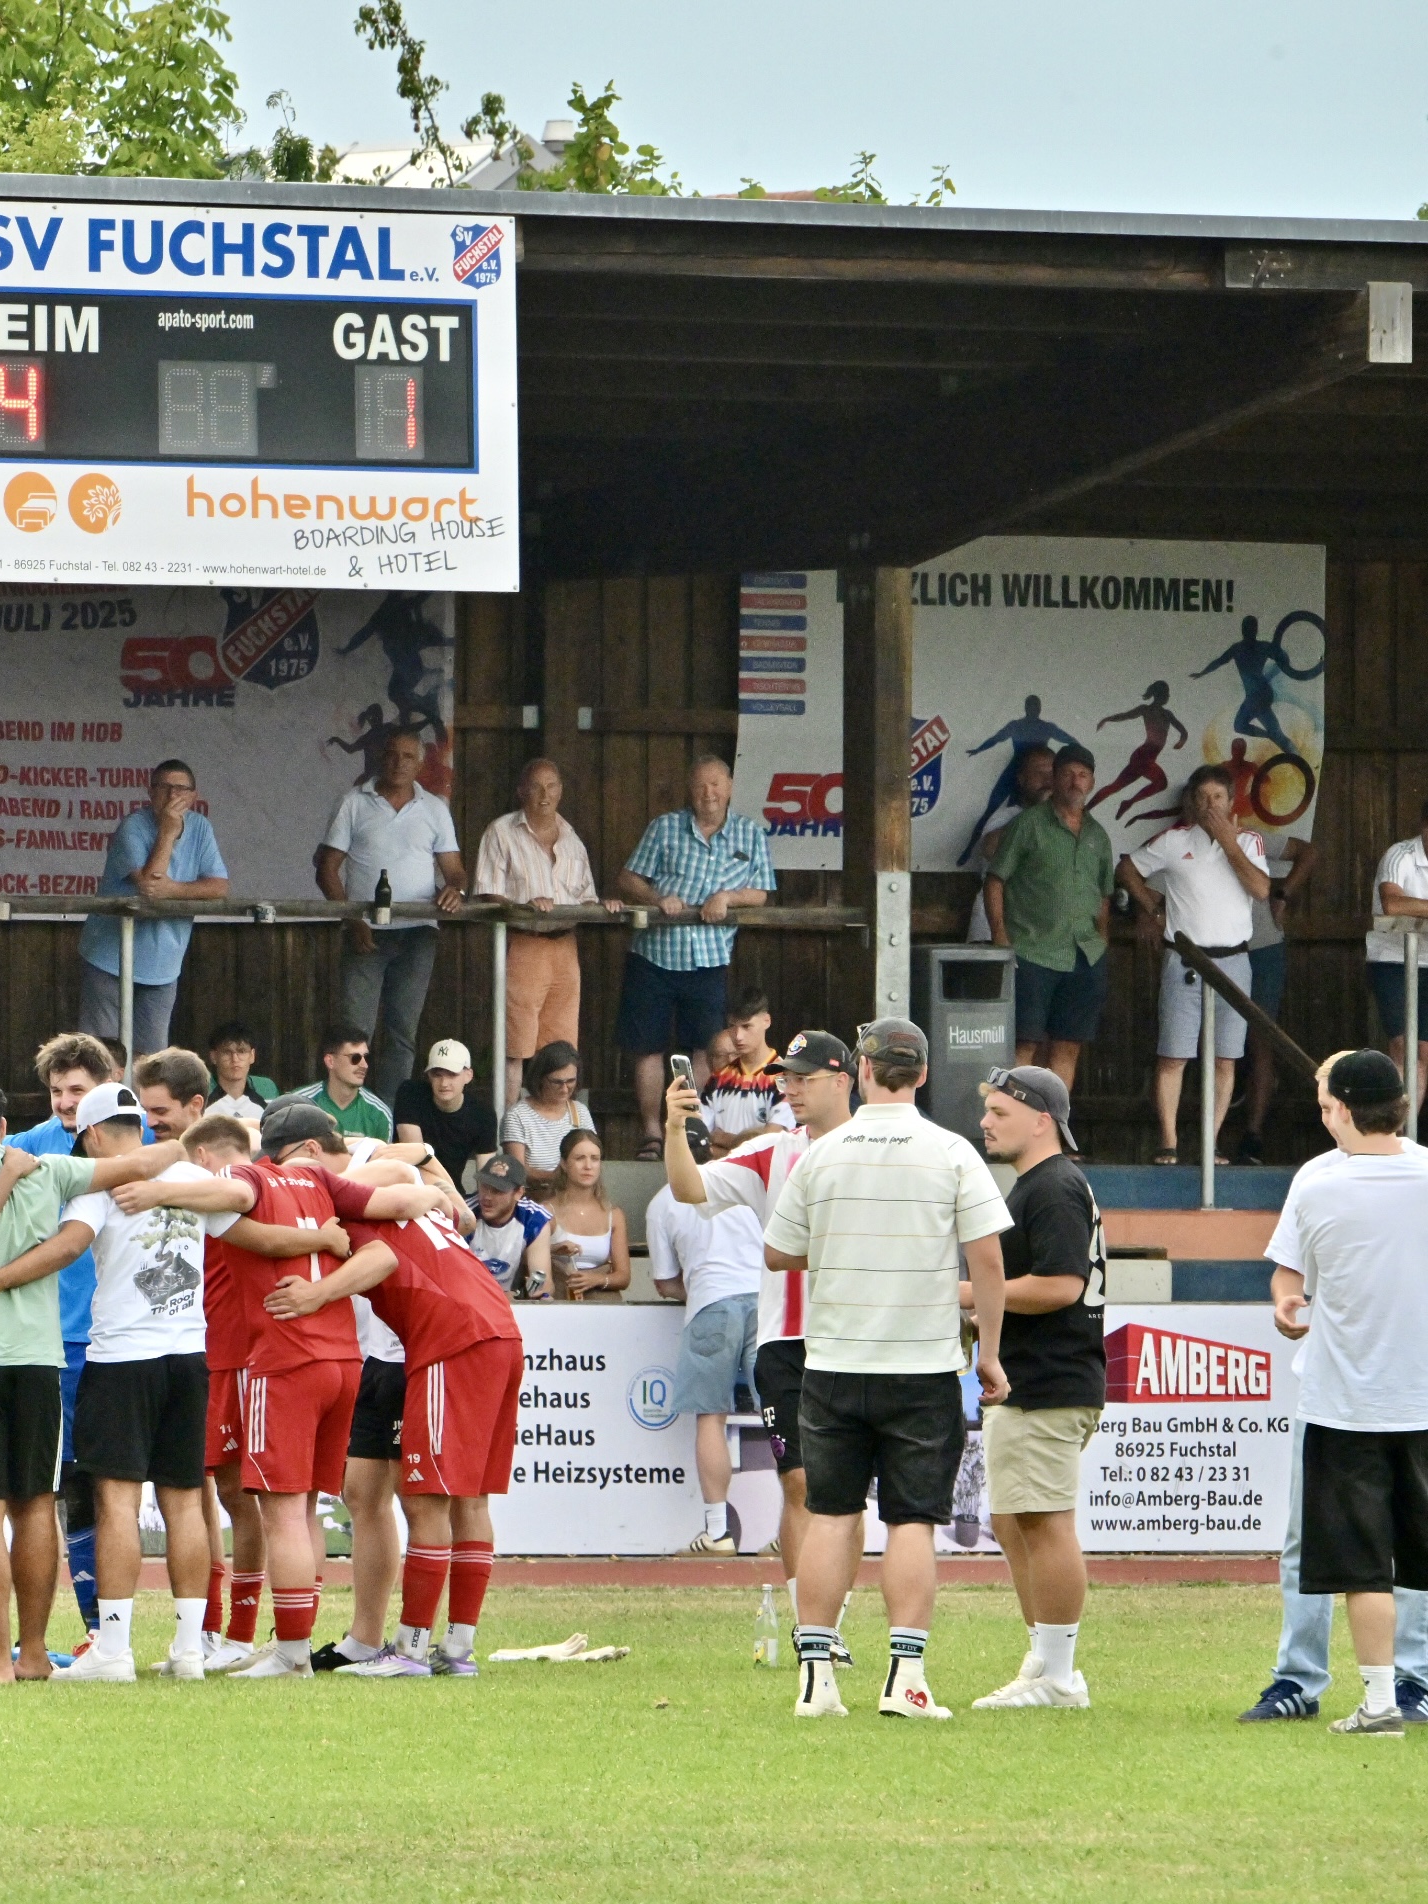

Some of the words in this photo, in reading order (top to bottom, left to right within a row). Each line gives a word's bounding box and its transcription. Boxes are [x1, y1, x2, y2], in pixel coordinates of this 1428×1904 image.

[455, 226, 473, 246] SV
[88, 217, 405, 281] FUCHSTAL
[409, 267, 439, 282] e.V.
[454, 226, 503, 276] FUCHSTAL
[482, 259, 498, 270] e.V.
[474, 272, 496, 284] 1975
[157, 310, 254, 331] apato-sport.com
[333, 312, 459, 361] GAST
[406, 377, 417, 450] 1
[186, 474, 479, 522] hohenwart
[294, 522, 416, 550] BOARDING
[430, 516, 506, 541] HOUSE
[14, 559, 46, 570] 86925
[49, 560, 92, 571] Fuchstal
[102, 561, 120, 572] Tel.
[122, 561, 142, 572] 082
[144, 562, 158, 572] 43
[167, 562, 192, 573] 2231
[202, 563, 327, 576] www.hohenwart-hotel.de
[348, 555, 363, 578] &
[378, 551, 458, 575] HOTEL
[1001, 574, 1236, 613] WILLKOMMEN!
[60, 600, 137, 632] 2025
[269, 658, 310, 677] 1975
[122, 686, 236, 708] JAHRE
[50, 720, 75, 741] IM
[82, 721, 123, 743] HDB
[949, 1025, 1005, 1044] Hausmüll
[1135, 1332, 1268, 1396] AMBERG
[518, 1386, 591, 1409] ehaus
[643, 1380, 666, 1407] IQ
[515, 1424, 596, 1446] ieHaus
[1132, 1418, 1162, 1433] Bau
[1167, 1417, 1218, 1433] GmbH
[1222, 1417, 1234, 1433] &
[1238, 1418, 1263, 1433] Co.
[1267, 1417, 1290, 1433] KG
[407, 1453, 421, 1464] 19
[1115, 1442, 1165, 1458] 86925
[1170, 1441, 1237, 1458] Fuchstal
[534, 1461, 685, 1490] Heizsysteme
[1100, 1466, 1133, 1482] Tel.:
[1136, 1467, 1146, 1482] 0
[1150, 1467, 1170, 1482] 82
[1174, 1467, 1194, 1482] 43
[1198, 1466, 1204, 1483] /
[1209, 1467, 1228, 1482] 23
[1232, 1467, 1250, 1482] 31
[1089, 1490, 1263, 1510] info@Amberg-Bau.de
[1091, 1515, 1262, 1535] www.amberg-bau.de
